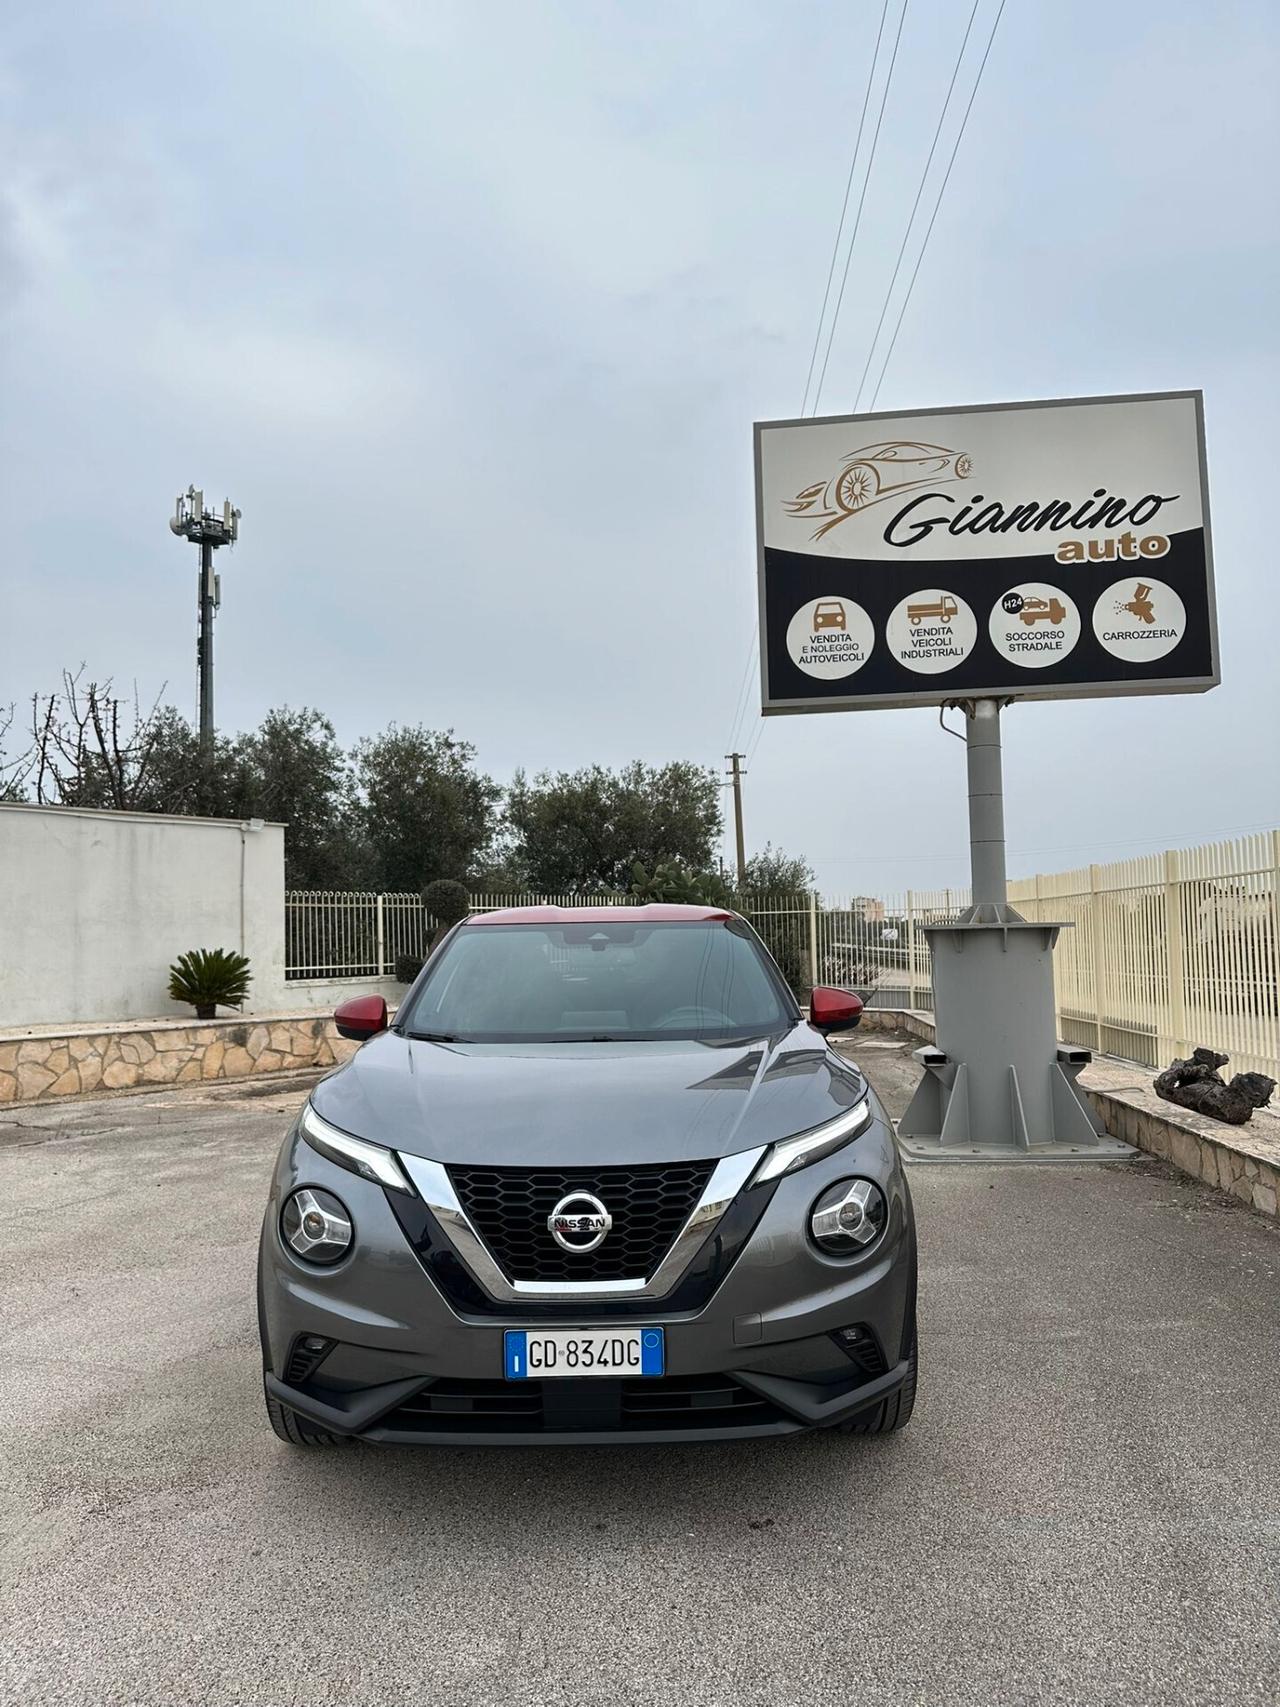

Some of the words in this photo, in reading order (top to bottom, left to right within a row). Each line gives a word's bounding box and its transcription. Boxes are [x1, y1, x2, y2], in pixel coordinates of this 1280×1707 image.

[883, 488, 1180, 547] Giannino
[1057, 531, 1169, 562] auto
[1004, 598, 1022, 609] H24
[910, 627, 953, 637] VENDITA
[1005, 630, 1065, 642] SOCCORSO
[1102, 629, 1178, 641] CARROZZERIA
[810, 634, 852, 644] VENDITA
[911, 638, 952, 648] VEICOLI
[810, 643, 859, 653] NOLEGGIO
[1008, 641, 1063, 652] STRADALE
[799, 652, 865, 664] AUTOVEICOLI
[900, 648, 964, 659] INDUSTRIALI
[554, 1218, 606, 1230] NISSAN
[529, 1340, 557, 1369] GD
[566, 1338, 640, 1368] 834DG
